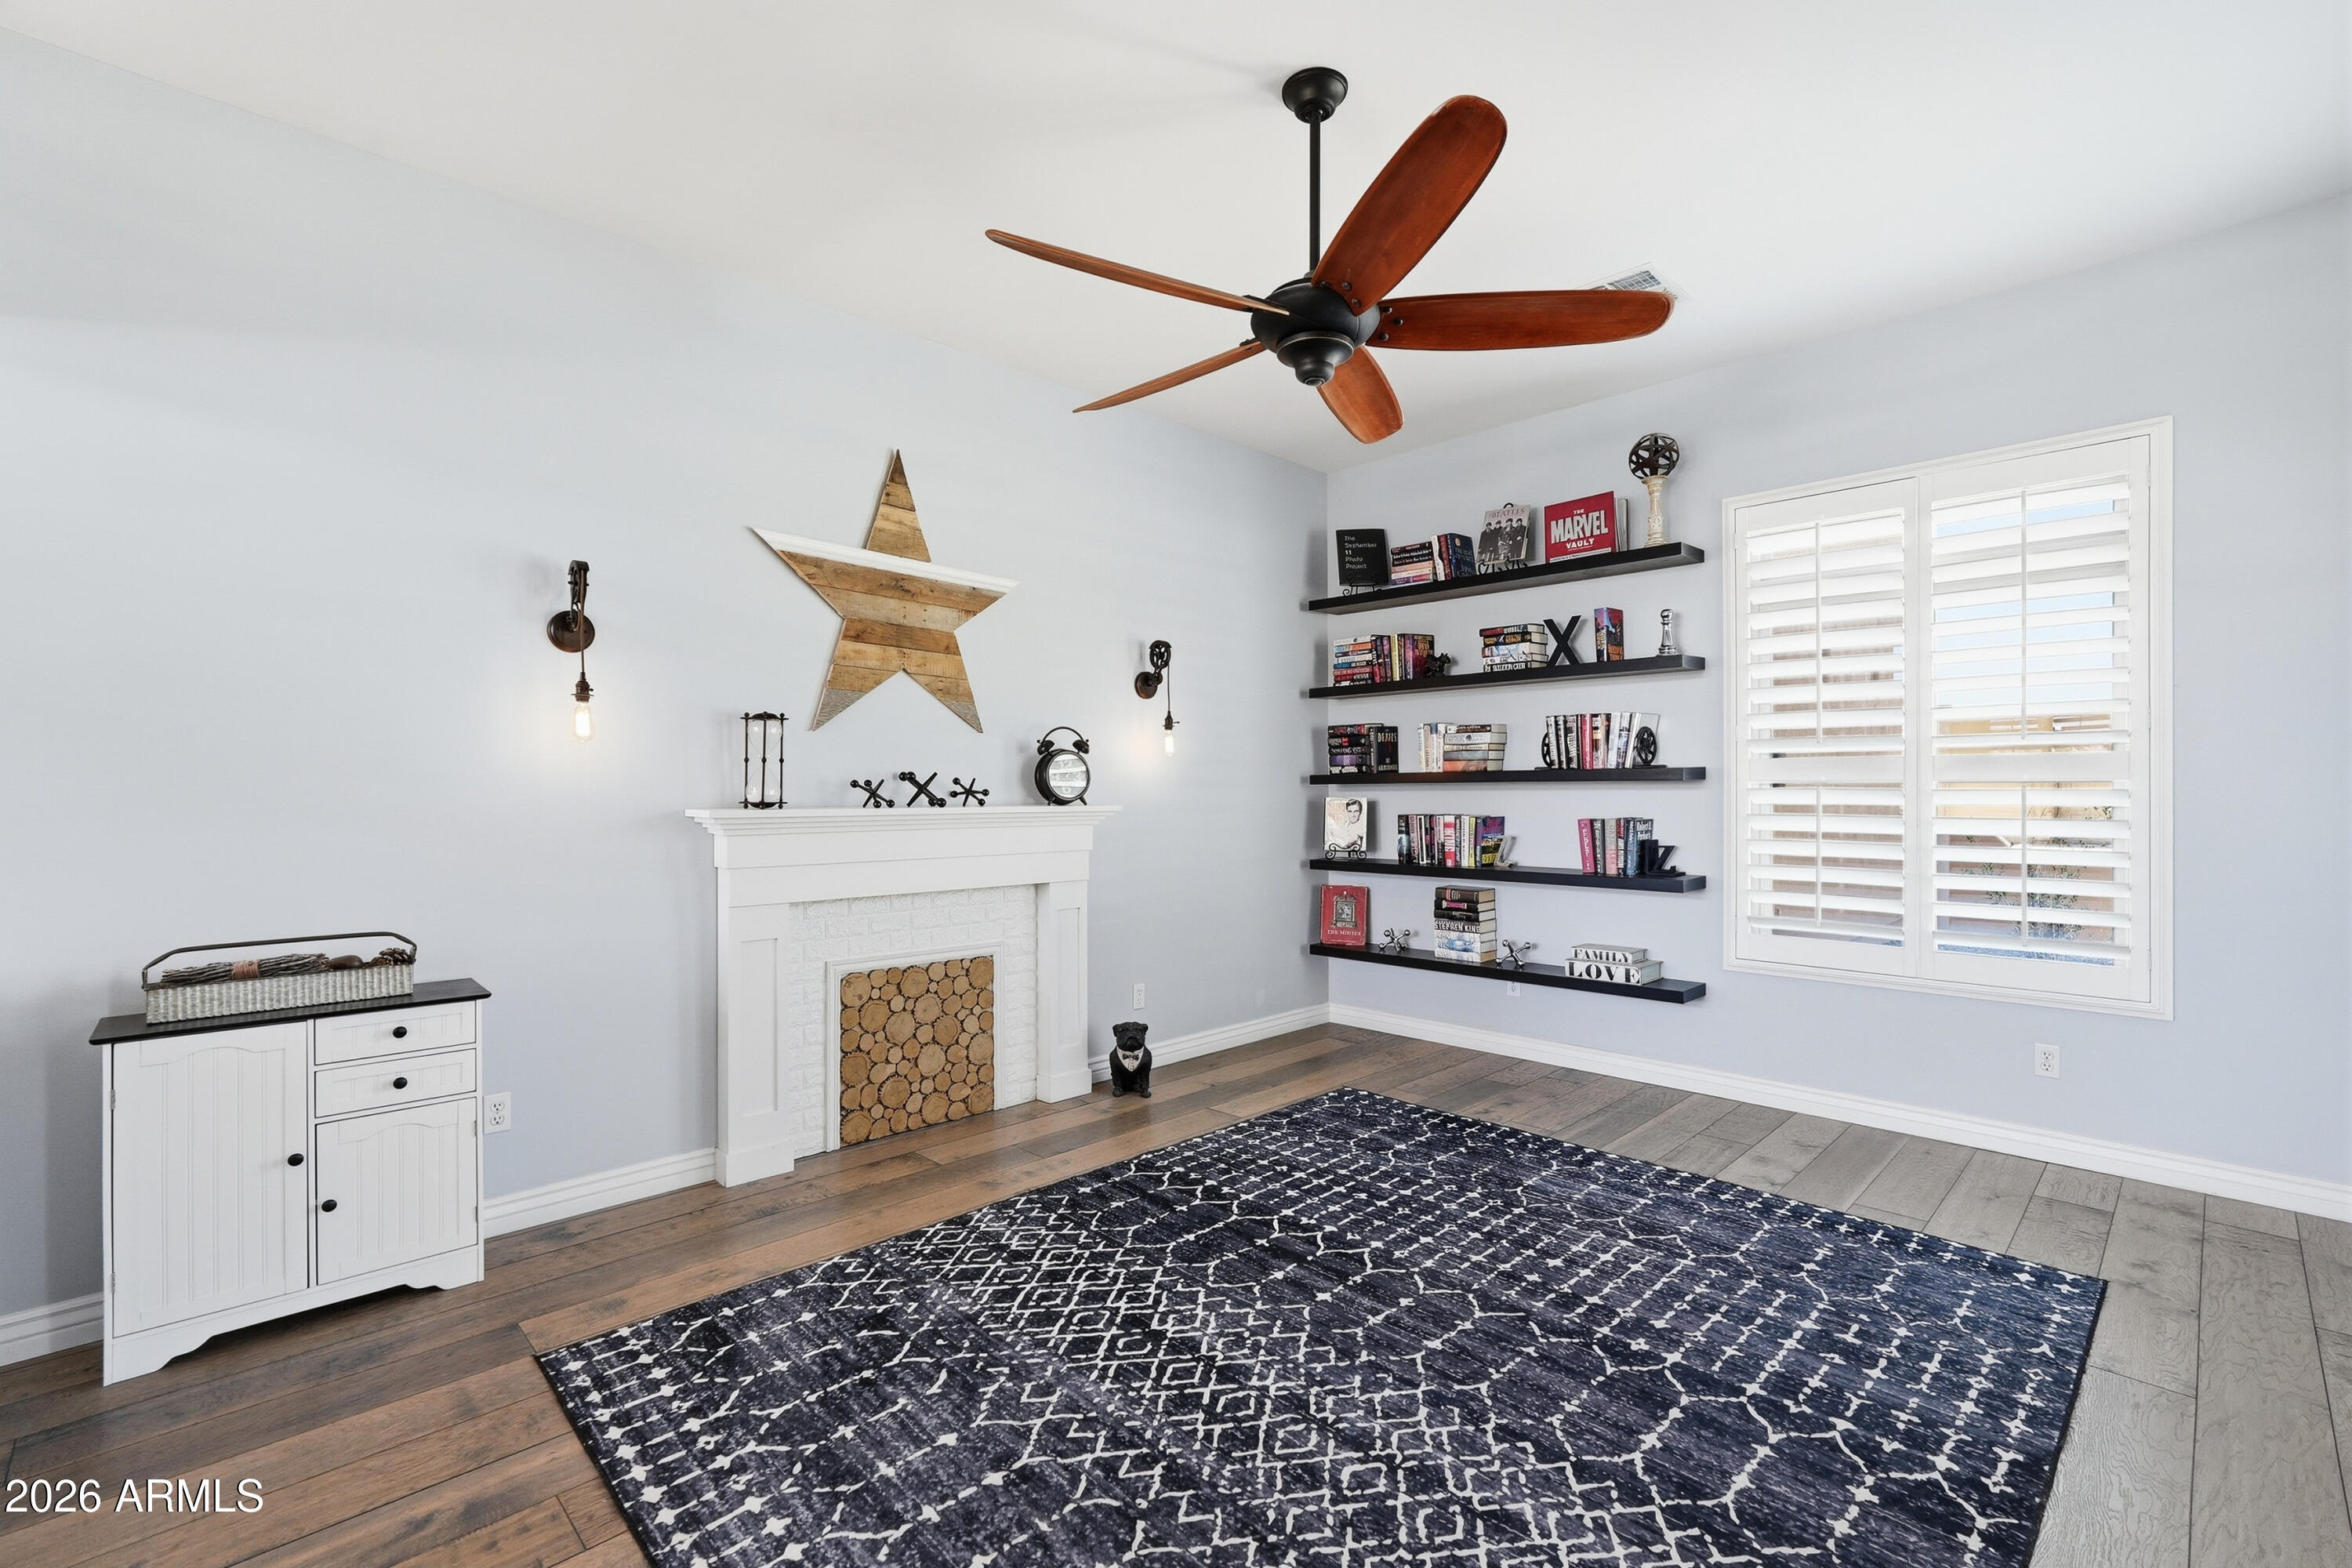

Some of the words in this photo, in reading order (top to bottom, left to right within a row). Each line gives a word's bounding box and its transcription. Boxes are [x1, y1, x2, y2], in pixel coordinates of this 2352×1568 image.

[1551, 510, 1608, 544] MARVEL
[1566, 538, 1595, 549] VAULT
[1543, 615, 1581, 665] X
[1434, 920, 1463, 931] STEPHEN
[1465, 924, 1480, 933] KING
[1573, 949, 1629, 963] FAMILY
[1568, 961, 1640, 984] LOVE
